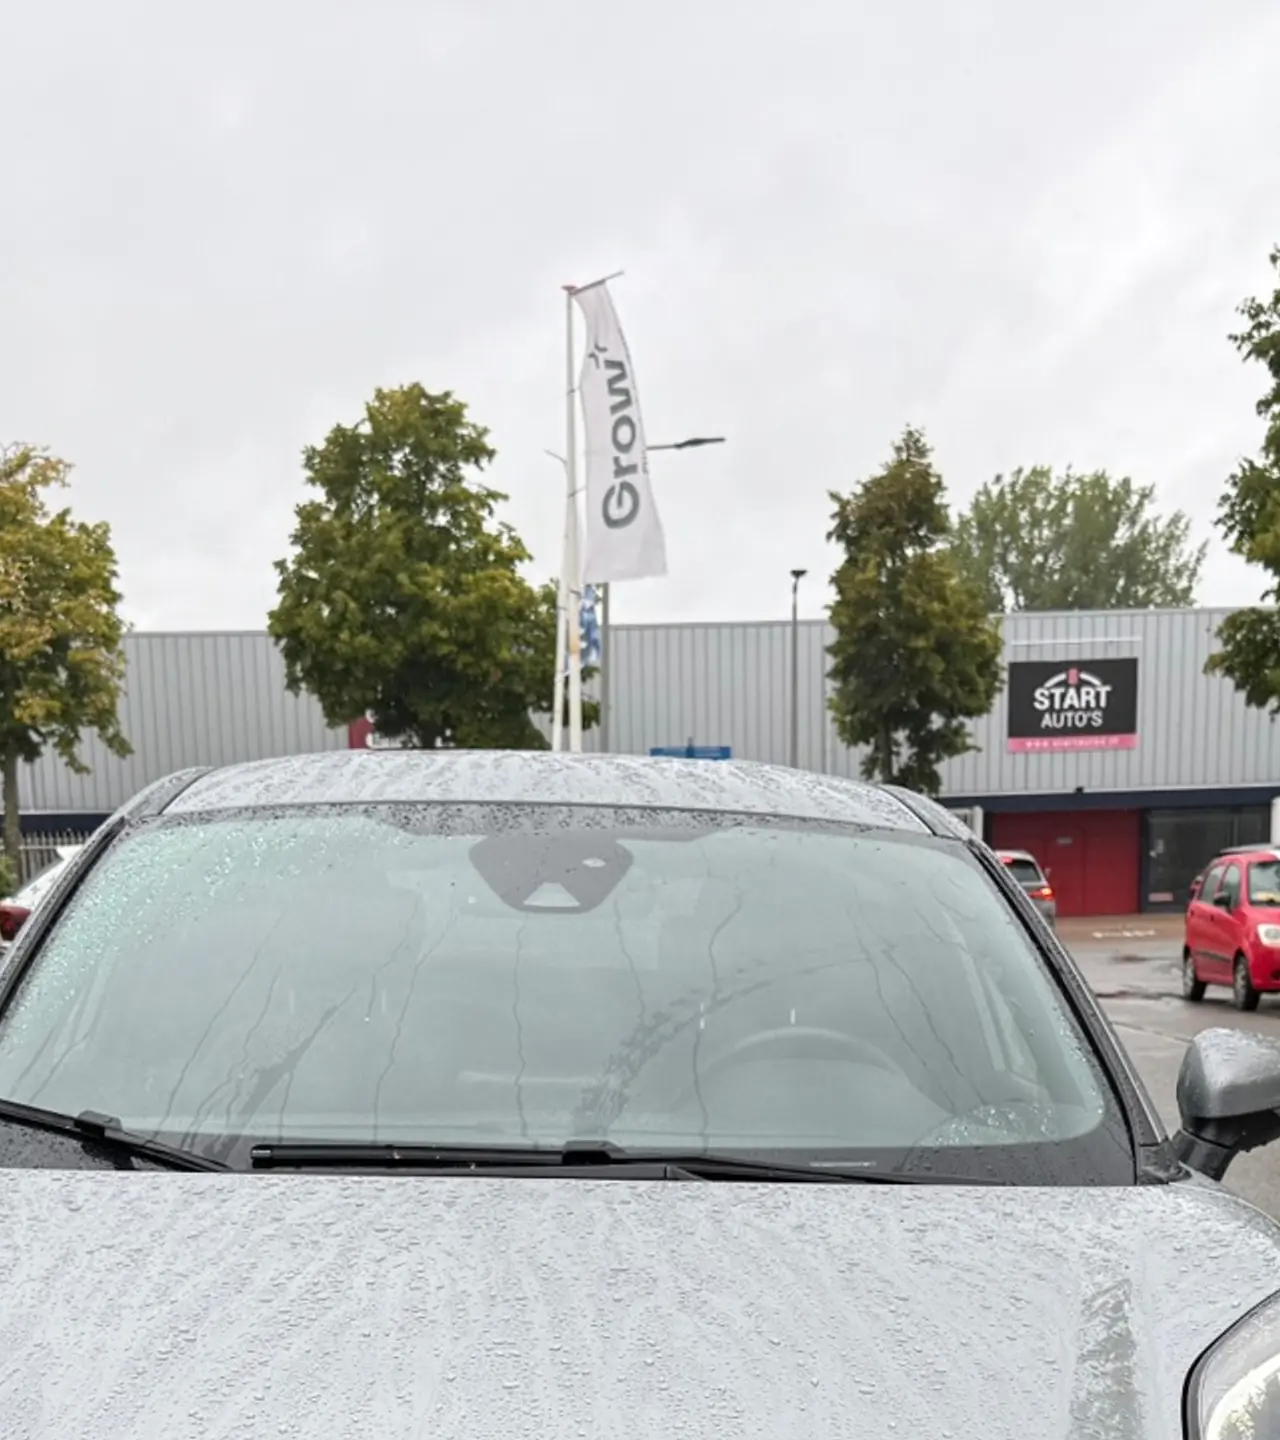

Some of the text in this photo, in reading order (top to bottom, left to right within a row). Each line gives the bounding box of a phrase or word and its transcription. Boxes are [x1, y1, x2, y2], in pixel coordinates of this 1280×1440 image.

[602, 359, 640, 529] Grow
[1033, 685, 1112, 710] START
[1040, 711, 1104, 729] AUTO'S
